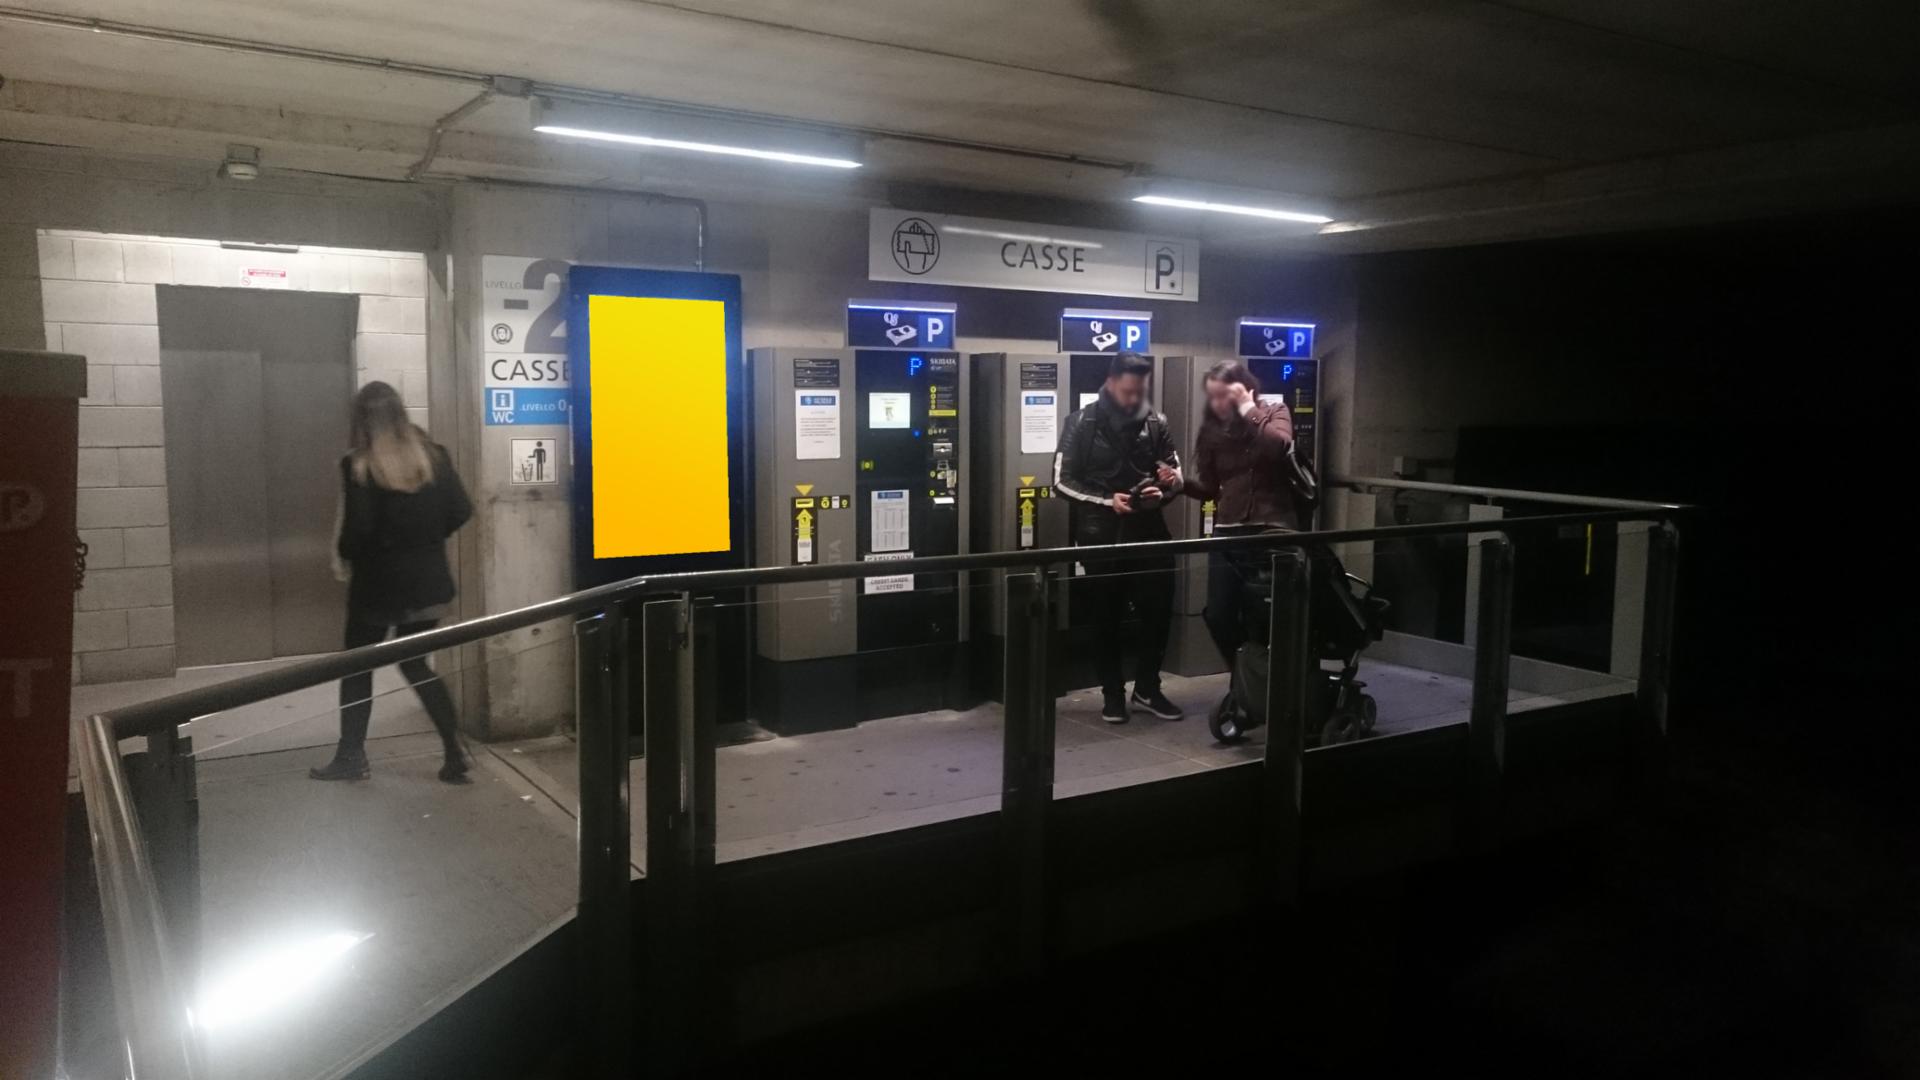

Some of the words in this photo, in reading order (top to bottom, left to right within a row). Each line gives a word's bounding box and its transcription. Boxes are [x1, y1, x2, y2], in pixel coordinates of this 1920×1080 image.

[1001, 241, 1085, 273] CASSE
[485, 280, 521, 289] LIVELLO
[928, 317, 944, 343] P
[1126, 325, 1141, 349] P
[1293, 331, 1305, 353] P
[909, 357, 922, 377] P
[1283, 364, 1292, 381] P
[522, 402, 556, 412] LIVELLO
[492, 411, 514, 424] WC
